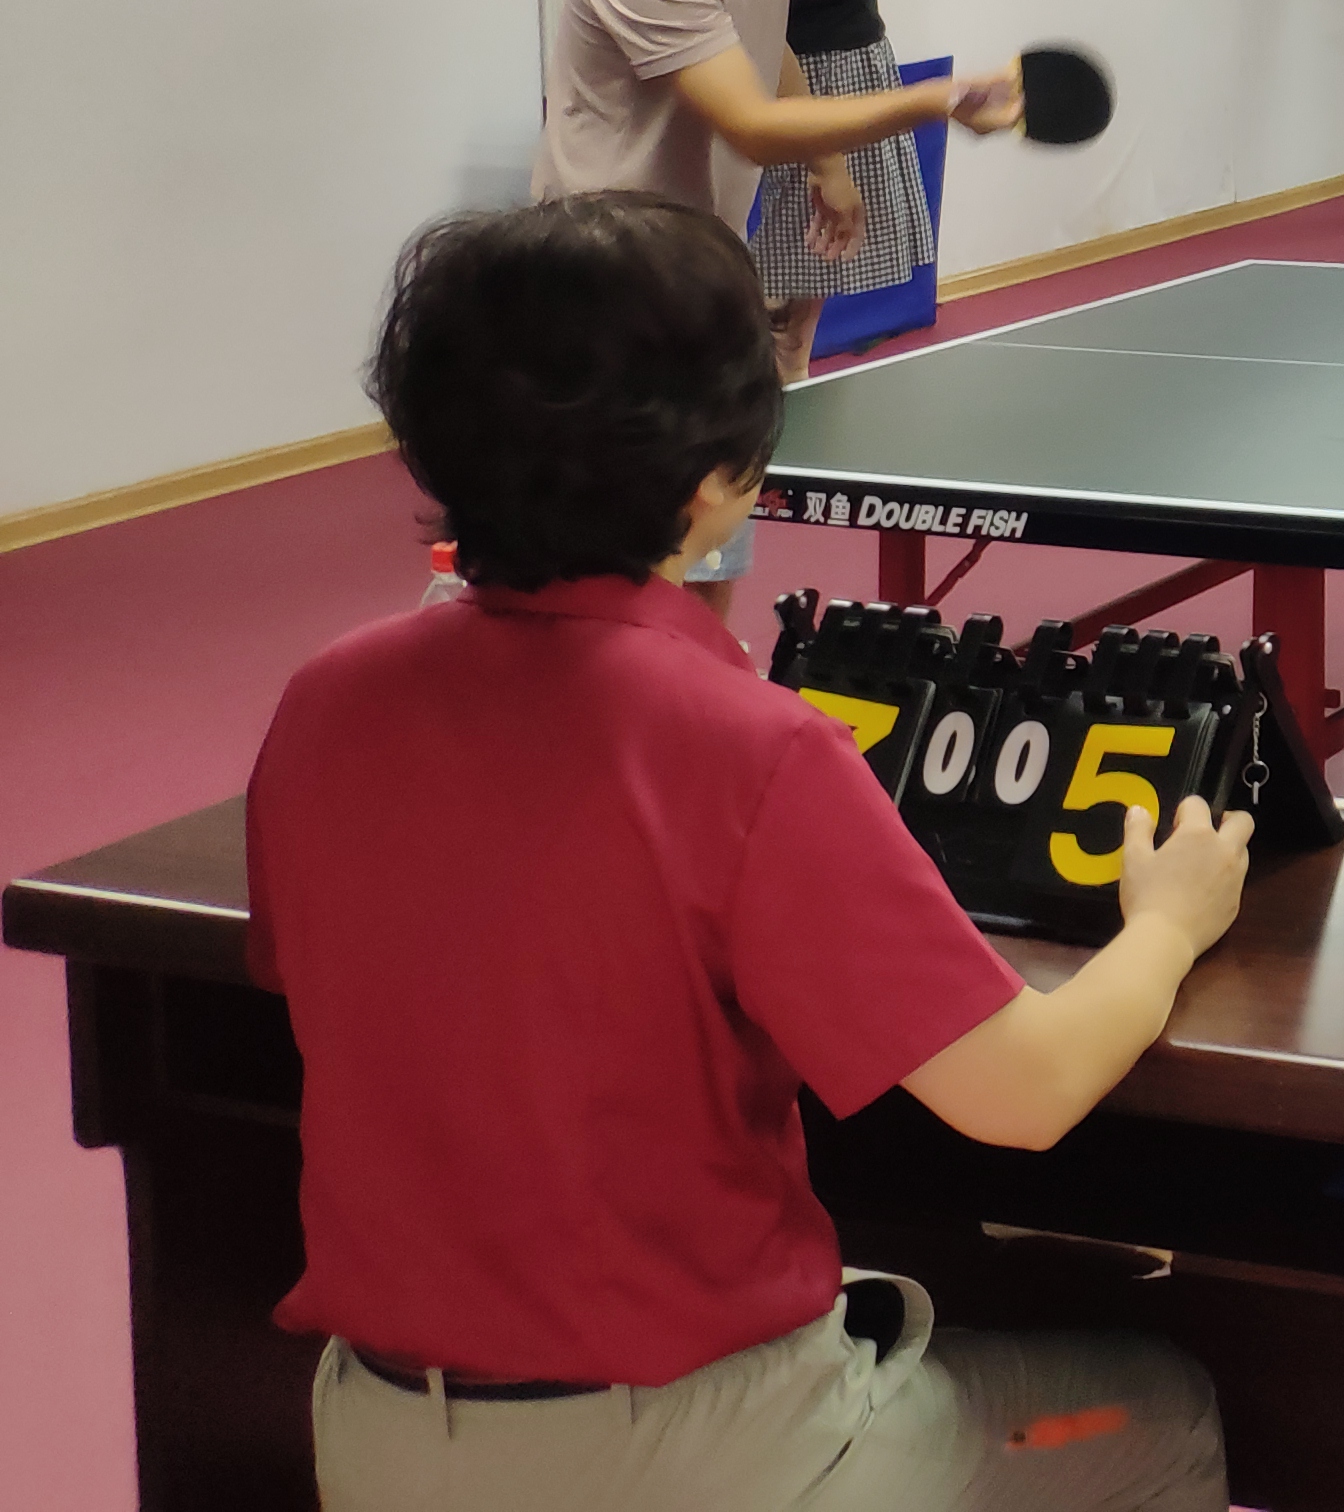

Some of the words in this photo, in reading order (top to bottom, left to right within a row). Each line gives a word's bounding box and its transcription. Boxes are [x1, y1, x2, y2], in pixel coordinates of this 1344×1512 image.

[803, 491, 850, 526] 双鱼
[857, 495, 966, 534] DOUBLE
[966, 509, 1028, 538] FISH
[1050, 723, 1176, 886] 5
